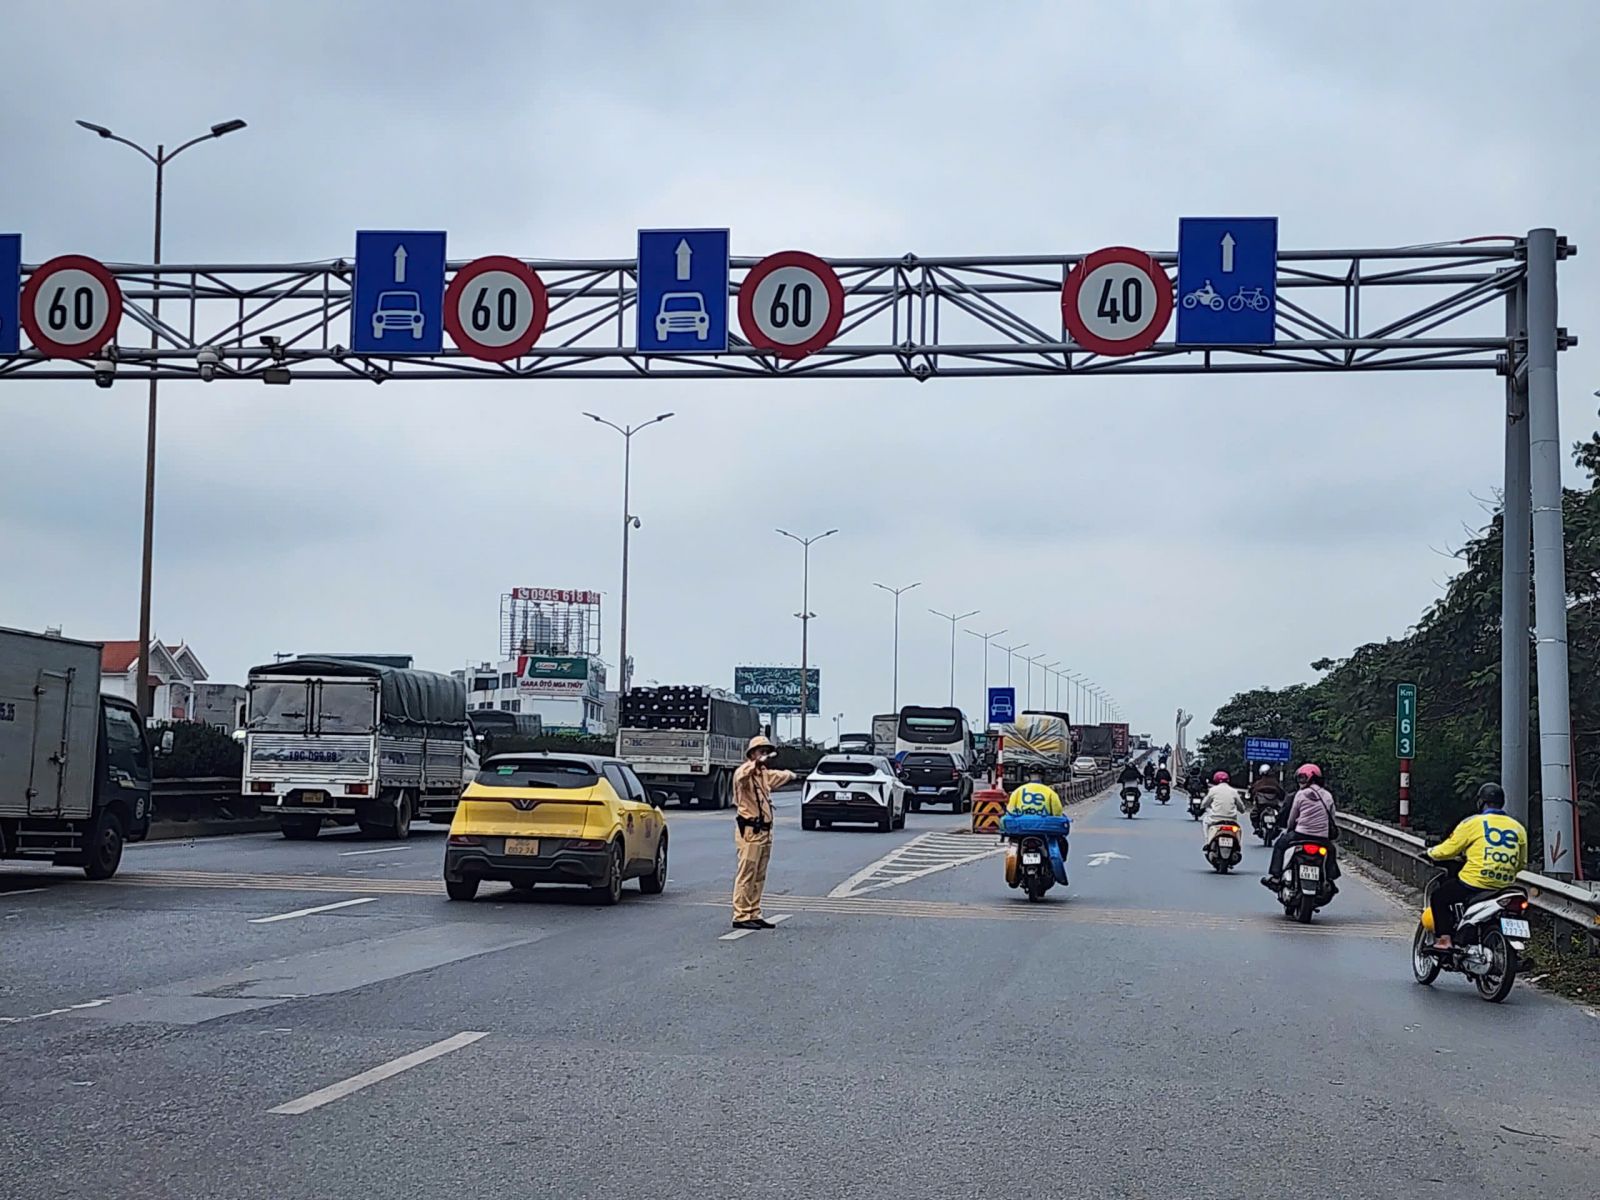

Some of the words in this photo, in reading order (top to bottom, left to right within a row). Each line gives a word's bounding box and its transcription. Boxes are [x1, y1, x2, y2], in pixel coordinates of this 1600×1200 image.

[48, 286, 95, 330] 60
[471, 286, 515, 331] 60
[770, 282, 812, 328] 60
[1097, 277, 1143, 323] 40
[531, 588, 559, 601] 0945
[1400, 689, 1413, 697] Km
[1022, 788, 1045, 805] be
[1483, 820, 1519, 849] be
